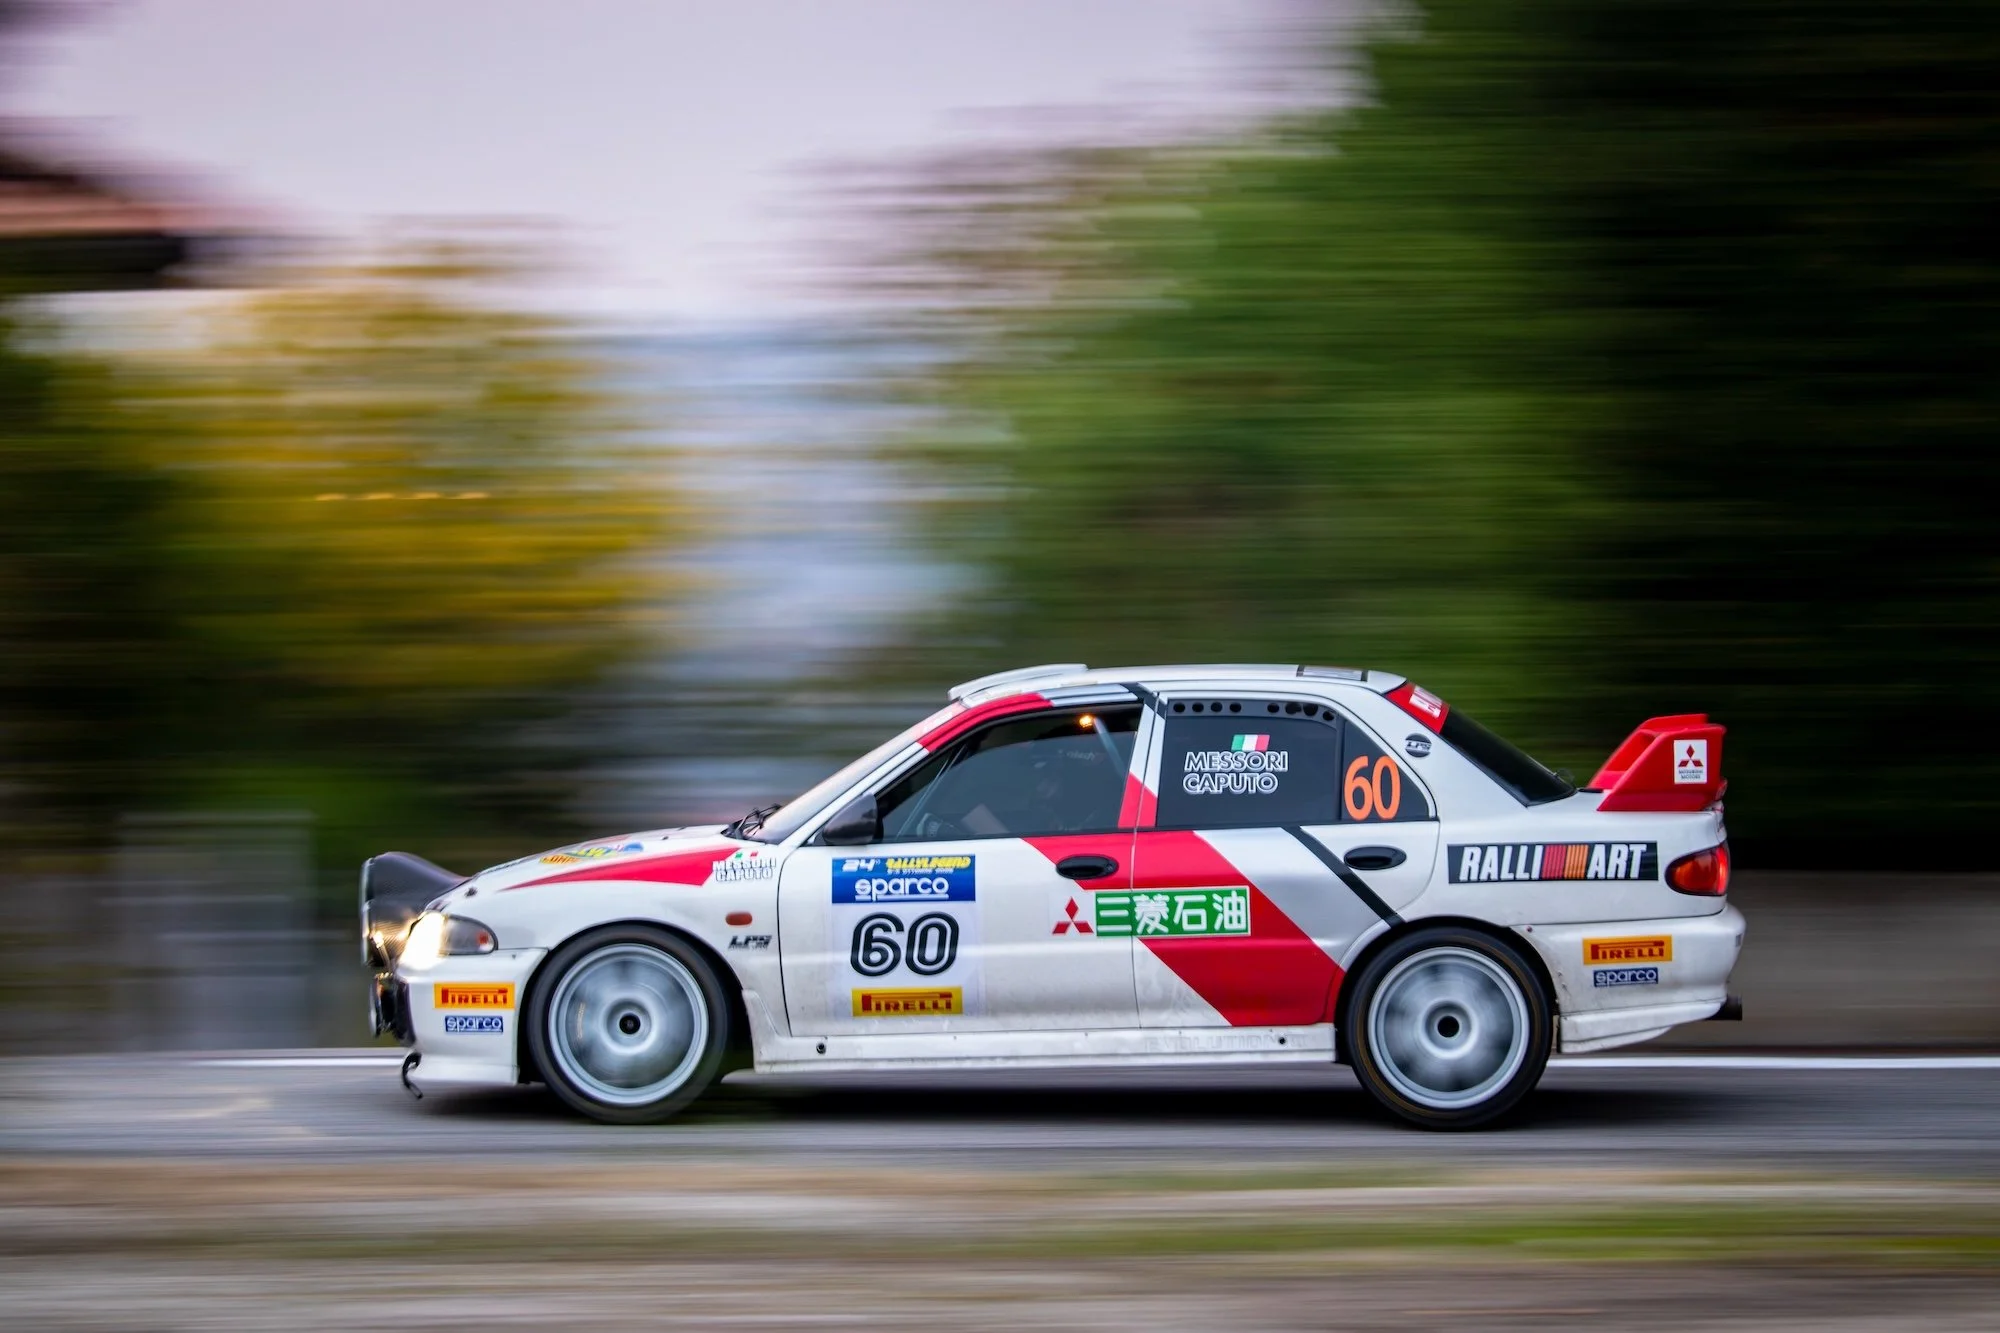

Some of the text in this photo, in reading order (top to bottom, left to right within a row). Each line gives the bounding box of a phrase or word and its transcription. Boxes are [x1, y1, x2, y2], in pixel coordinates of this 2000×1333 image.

[1184, 751, 1288, 772] MESSORI
[1183, 772, 1278, 794] CAPUTO
[1344, 755, 1401, 820] 60
[712, 857, 776, 871] MESSORI
[1586, 844, 1647, 881] ART
[716, 867, 773, 881] CAPUTO
[855, 877, 949, 901] sparco
[1097, 890, 1246, 934] 三菱石油
[850, 911, 960, 977] 60
[1590, 940, 1665, 960] PIRELLI
[1595, 969, 1657, 986] sparco
[441, 988, 508, 1005] PIRELLI
[861, 992, 953, 1012] PIRELLI
[446, 1016, 503, 1032] sparco
